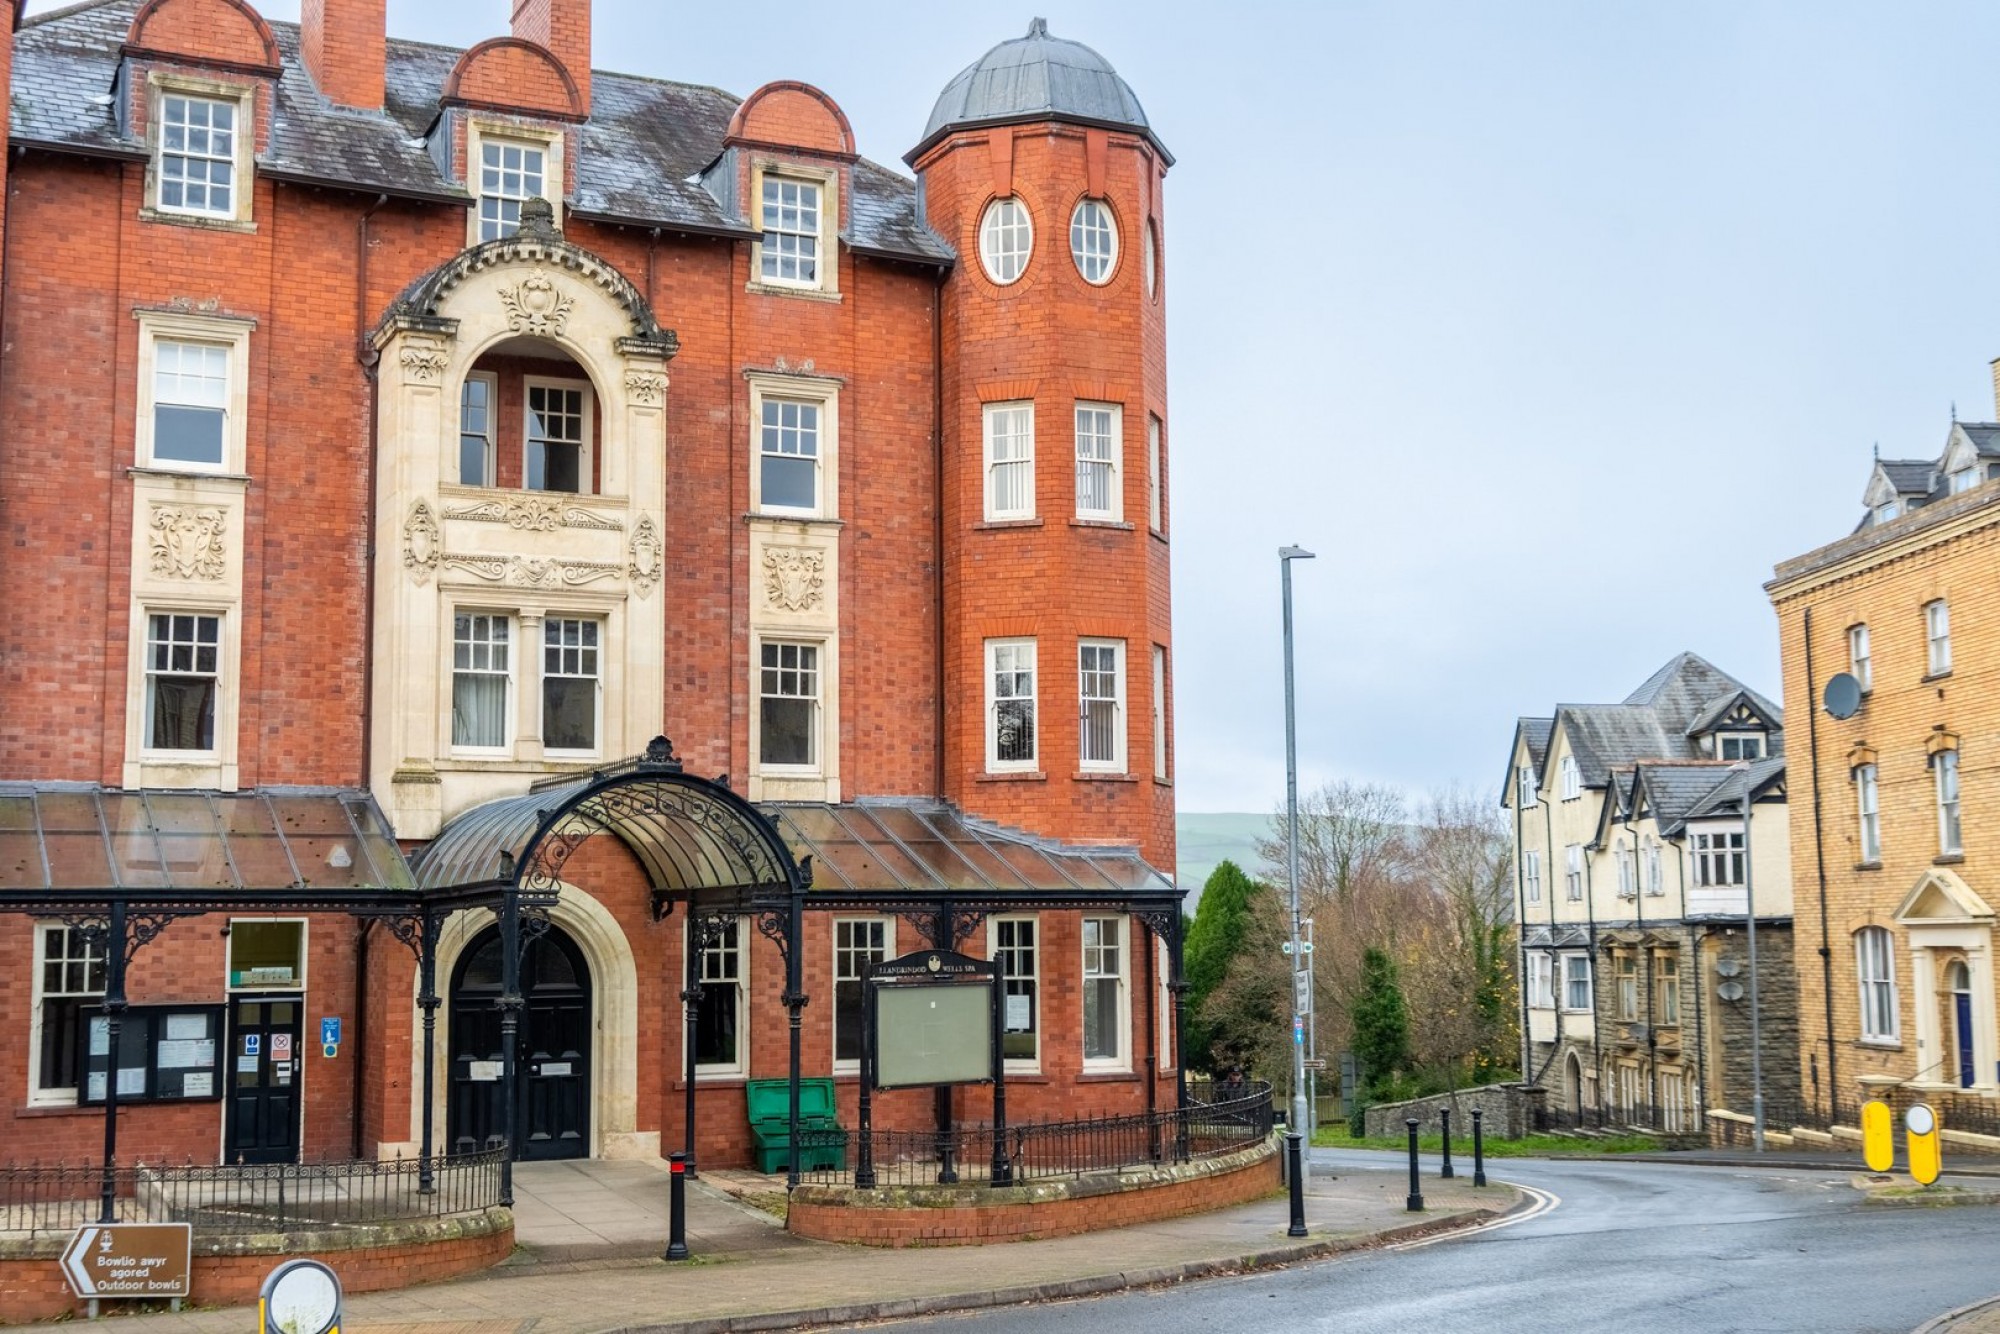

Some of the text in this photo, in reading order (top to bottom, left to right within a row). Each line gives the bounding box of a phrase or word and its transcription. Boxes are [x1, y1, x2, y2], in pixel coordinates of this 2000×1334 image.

[97, 1256, 167, 1267] Bowlio awyr
[110, 1268, 149, 1279] agored
[97, 1280, 181, 1290] Outdoor bowls
